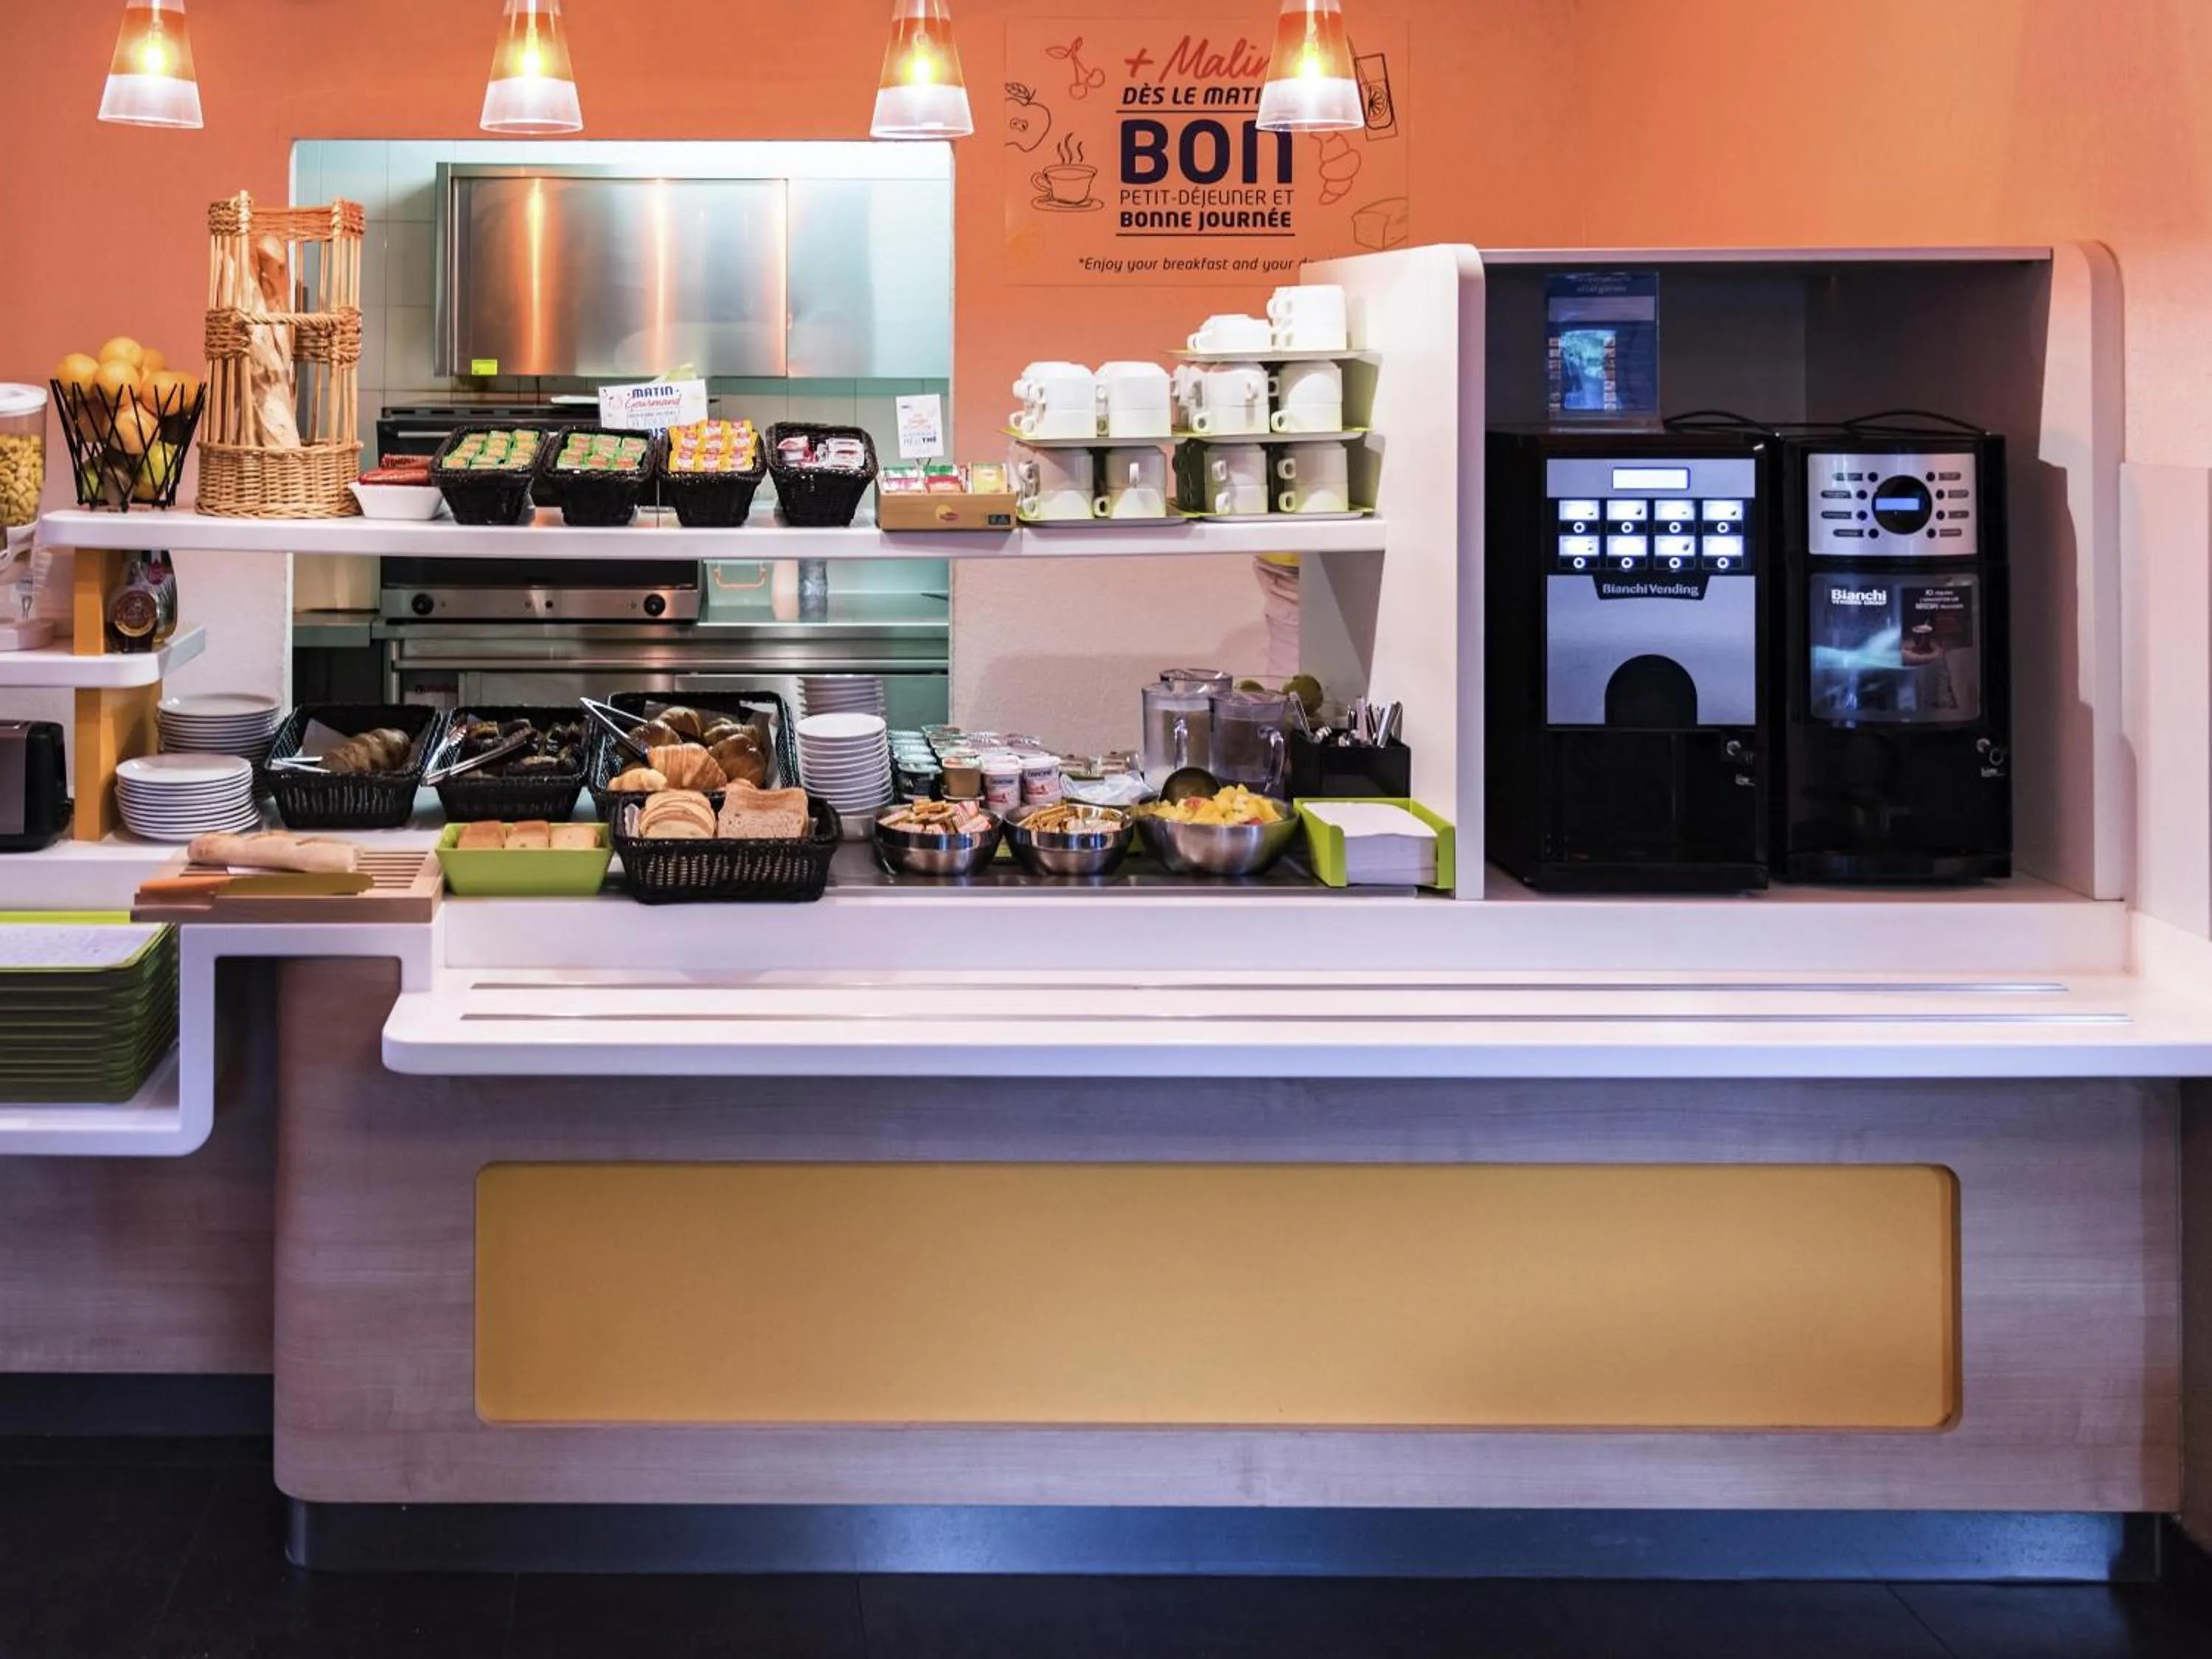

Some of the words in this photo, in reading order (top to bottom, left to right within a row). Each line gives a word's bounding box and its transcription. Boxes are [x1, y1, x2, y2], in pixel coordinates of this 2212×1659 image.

[1122, 83, 1165, 105] DÈS
[1172, 86, 1197, 105] LE
[1203, 86, 1264, 105] MATI
[1120, 119, 1293, 185] BON
[1120, 187, 1267, 209] PETIT-DÉJEUNER
[1273, 189, 1295, 206] ET
[1120, 211, 1192, 228] BONNE
[1198, 207, 1291, 232] JOURNÉE
[1127, 260, 1158, 273] your
[1163, 257, 1228, 271] breakfast
[1232, 257, 1259, 271] and
[1262, 260, 1292, 273] your
[632, 386, 674, 399] MATIN
[1602, 582, 1648, 594] Bianchi
[1649, 583, 1699, 597] Vending
[1831, 588, 1887, 600] Bianchi
